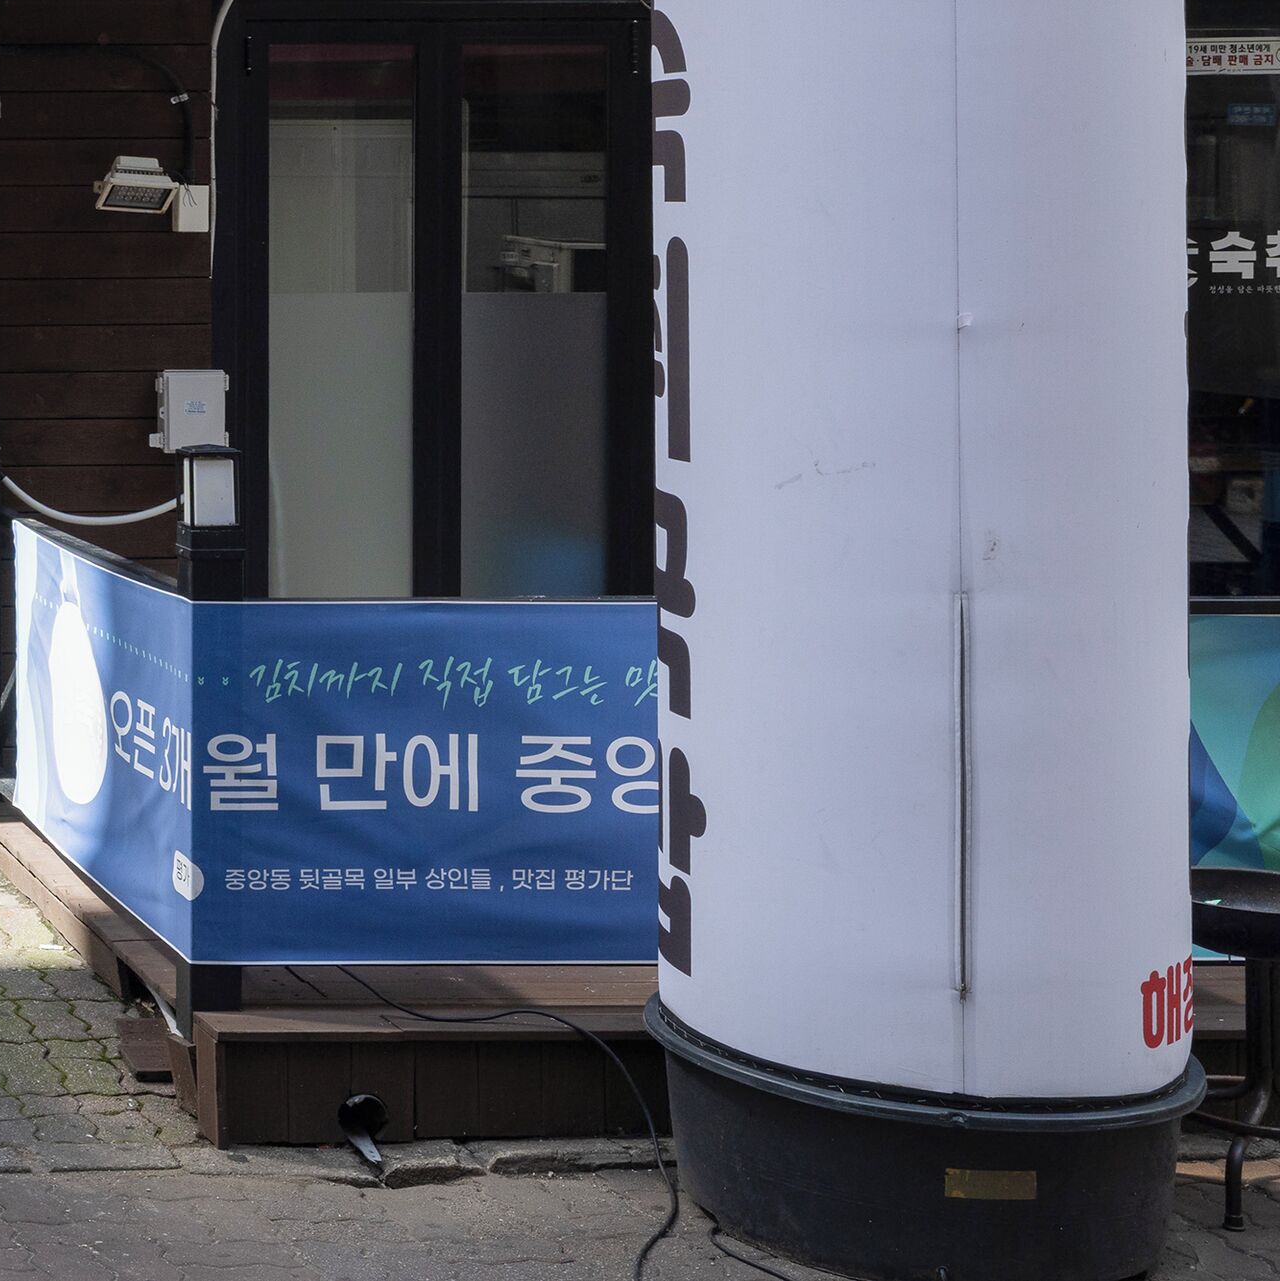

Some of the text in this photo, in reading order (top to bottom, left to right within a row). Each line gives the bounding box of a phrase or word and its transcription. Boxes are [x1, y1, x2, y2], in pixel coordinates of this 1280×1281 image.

[1253, 55, 1274, 65] 금지
[249, 657, 403, 704] 김치까지
[418, 655, 494, 710] 직접
[508, 658, 605, 706] 담그는
[110, 690, 156, 780] 오픈
[316, 733, 479, 813] 만에
[224, 869, 290, 891] 중앙동
[299, 869, 366, 891] 뒷골목
[373, 869, 416, 891] 일부
[511, 869, 555, 891] 맛집
[564, 869, 634, 891] 평가단
